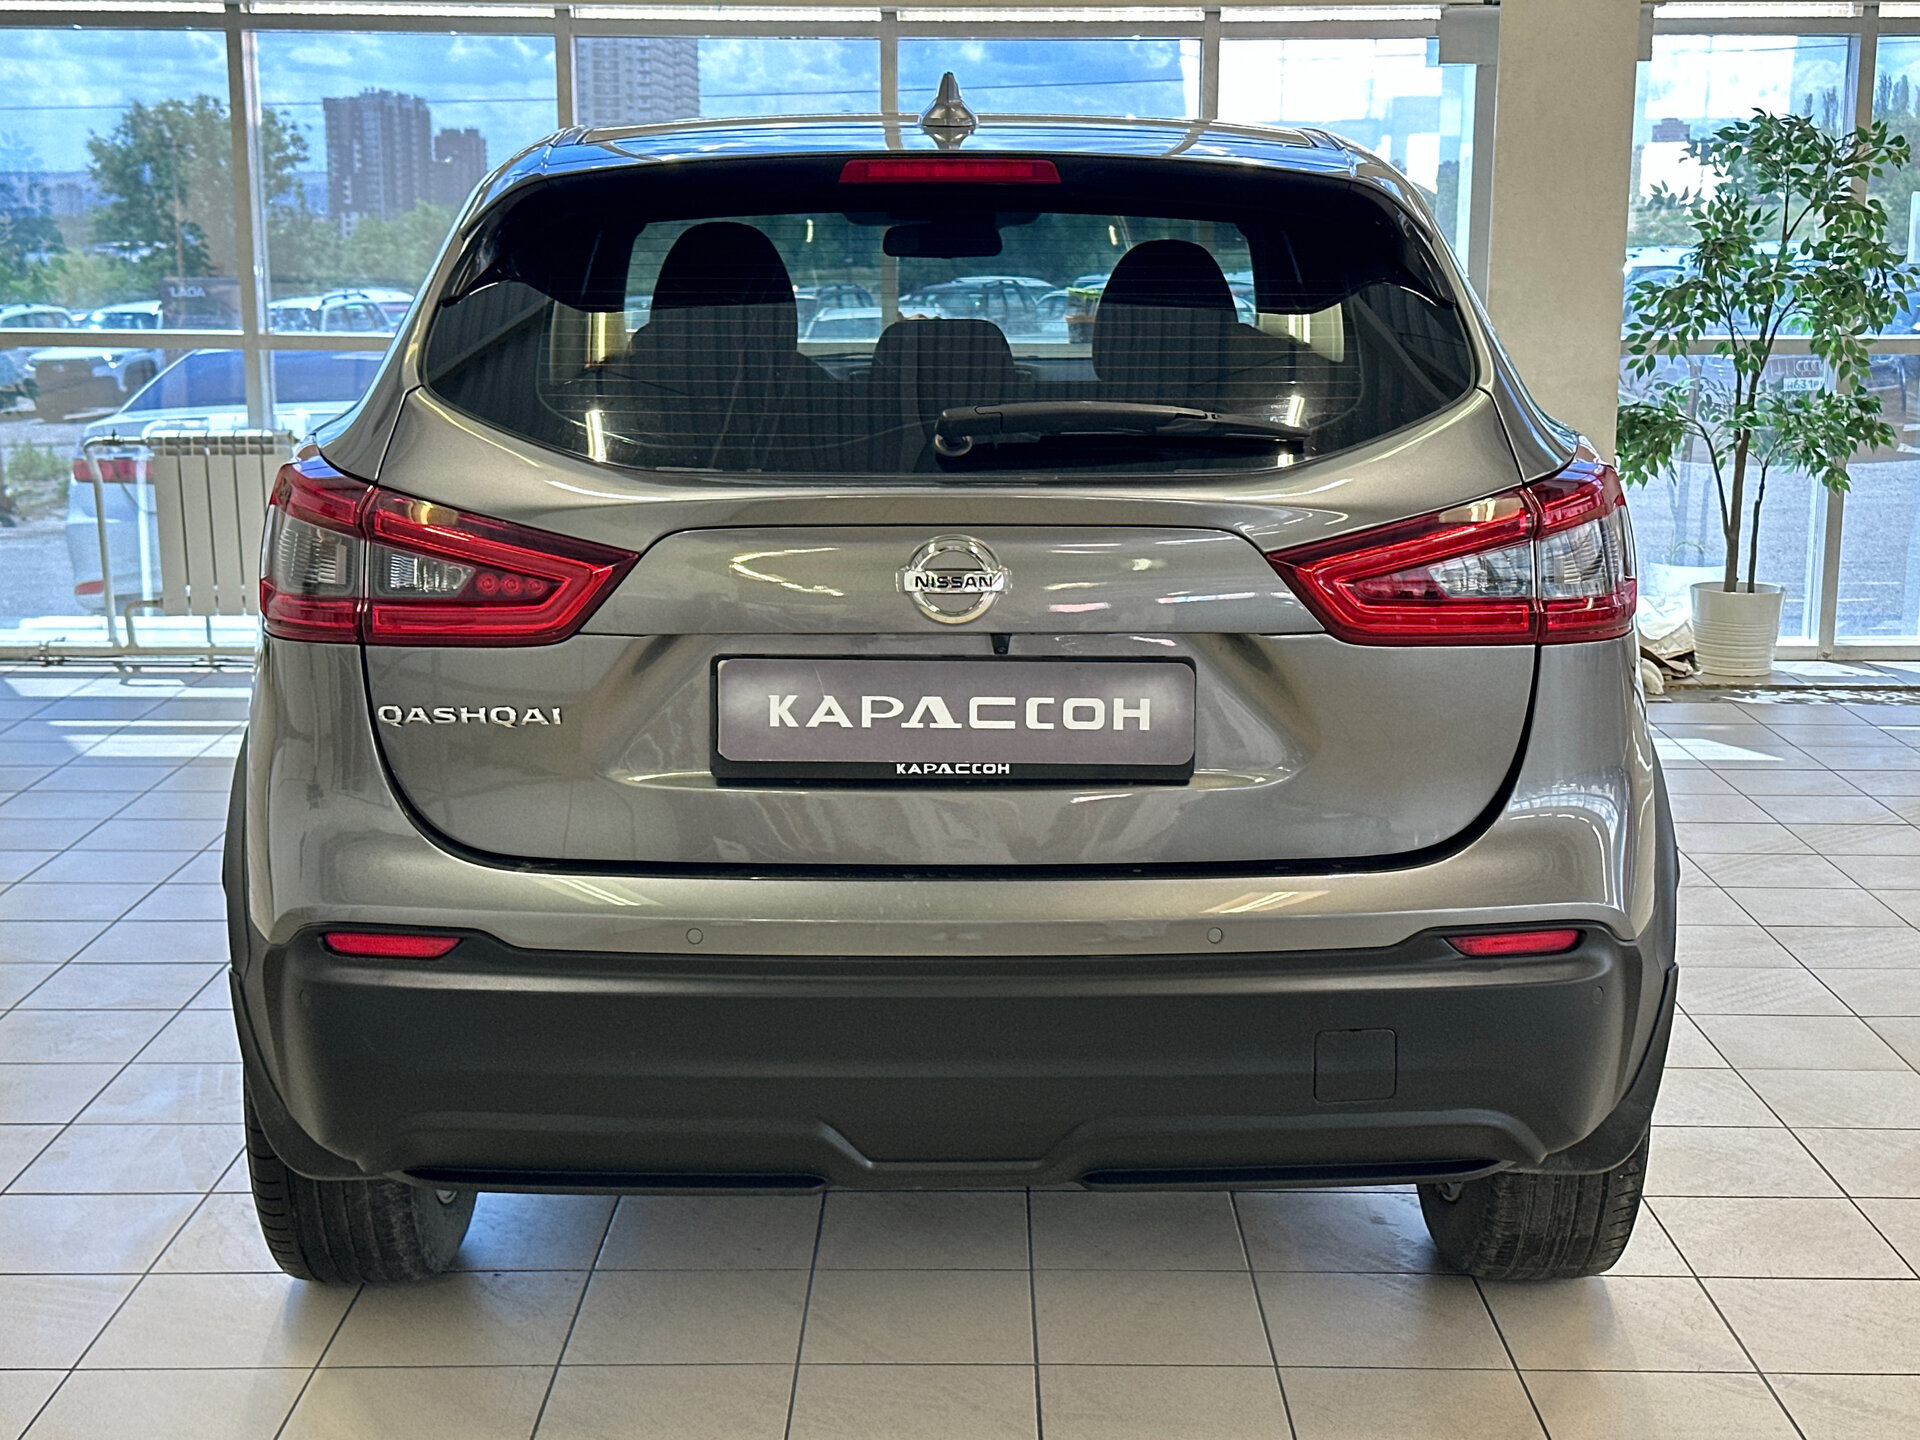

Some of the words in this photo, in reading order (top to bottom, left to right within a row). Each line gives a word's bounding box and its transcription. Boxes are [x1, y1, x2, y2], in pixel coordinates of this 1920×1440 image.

[915, 576, 993, 588] NISSAN
[377, 705, 562, 728] QASHQAI
[768, 694, 1151, 731] КАРАССОН
[896, 763, 1010, 775] КАРАССОН
